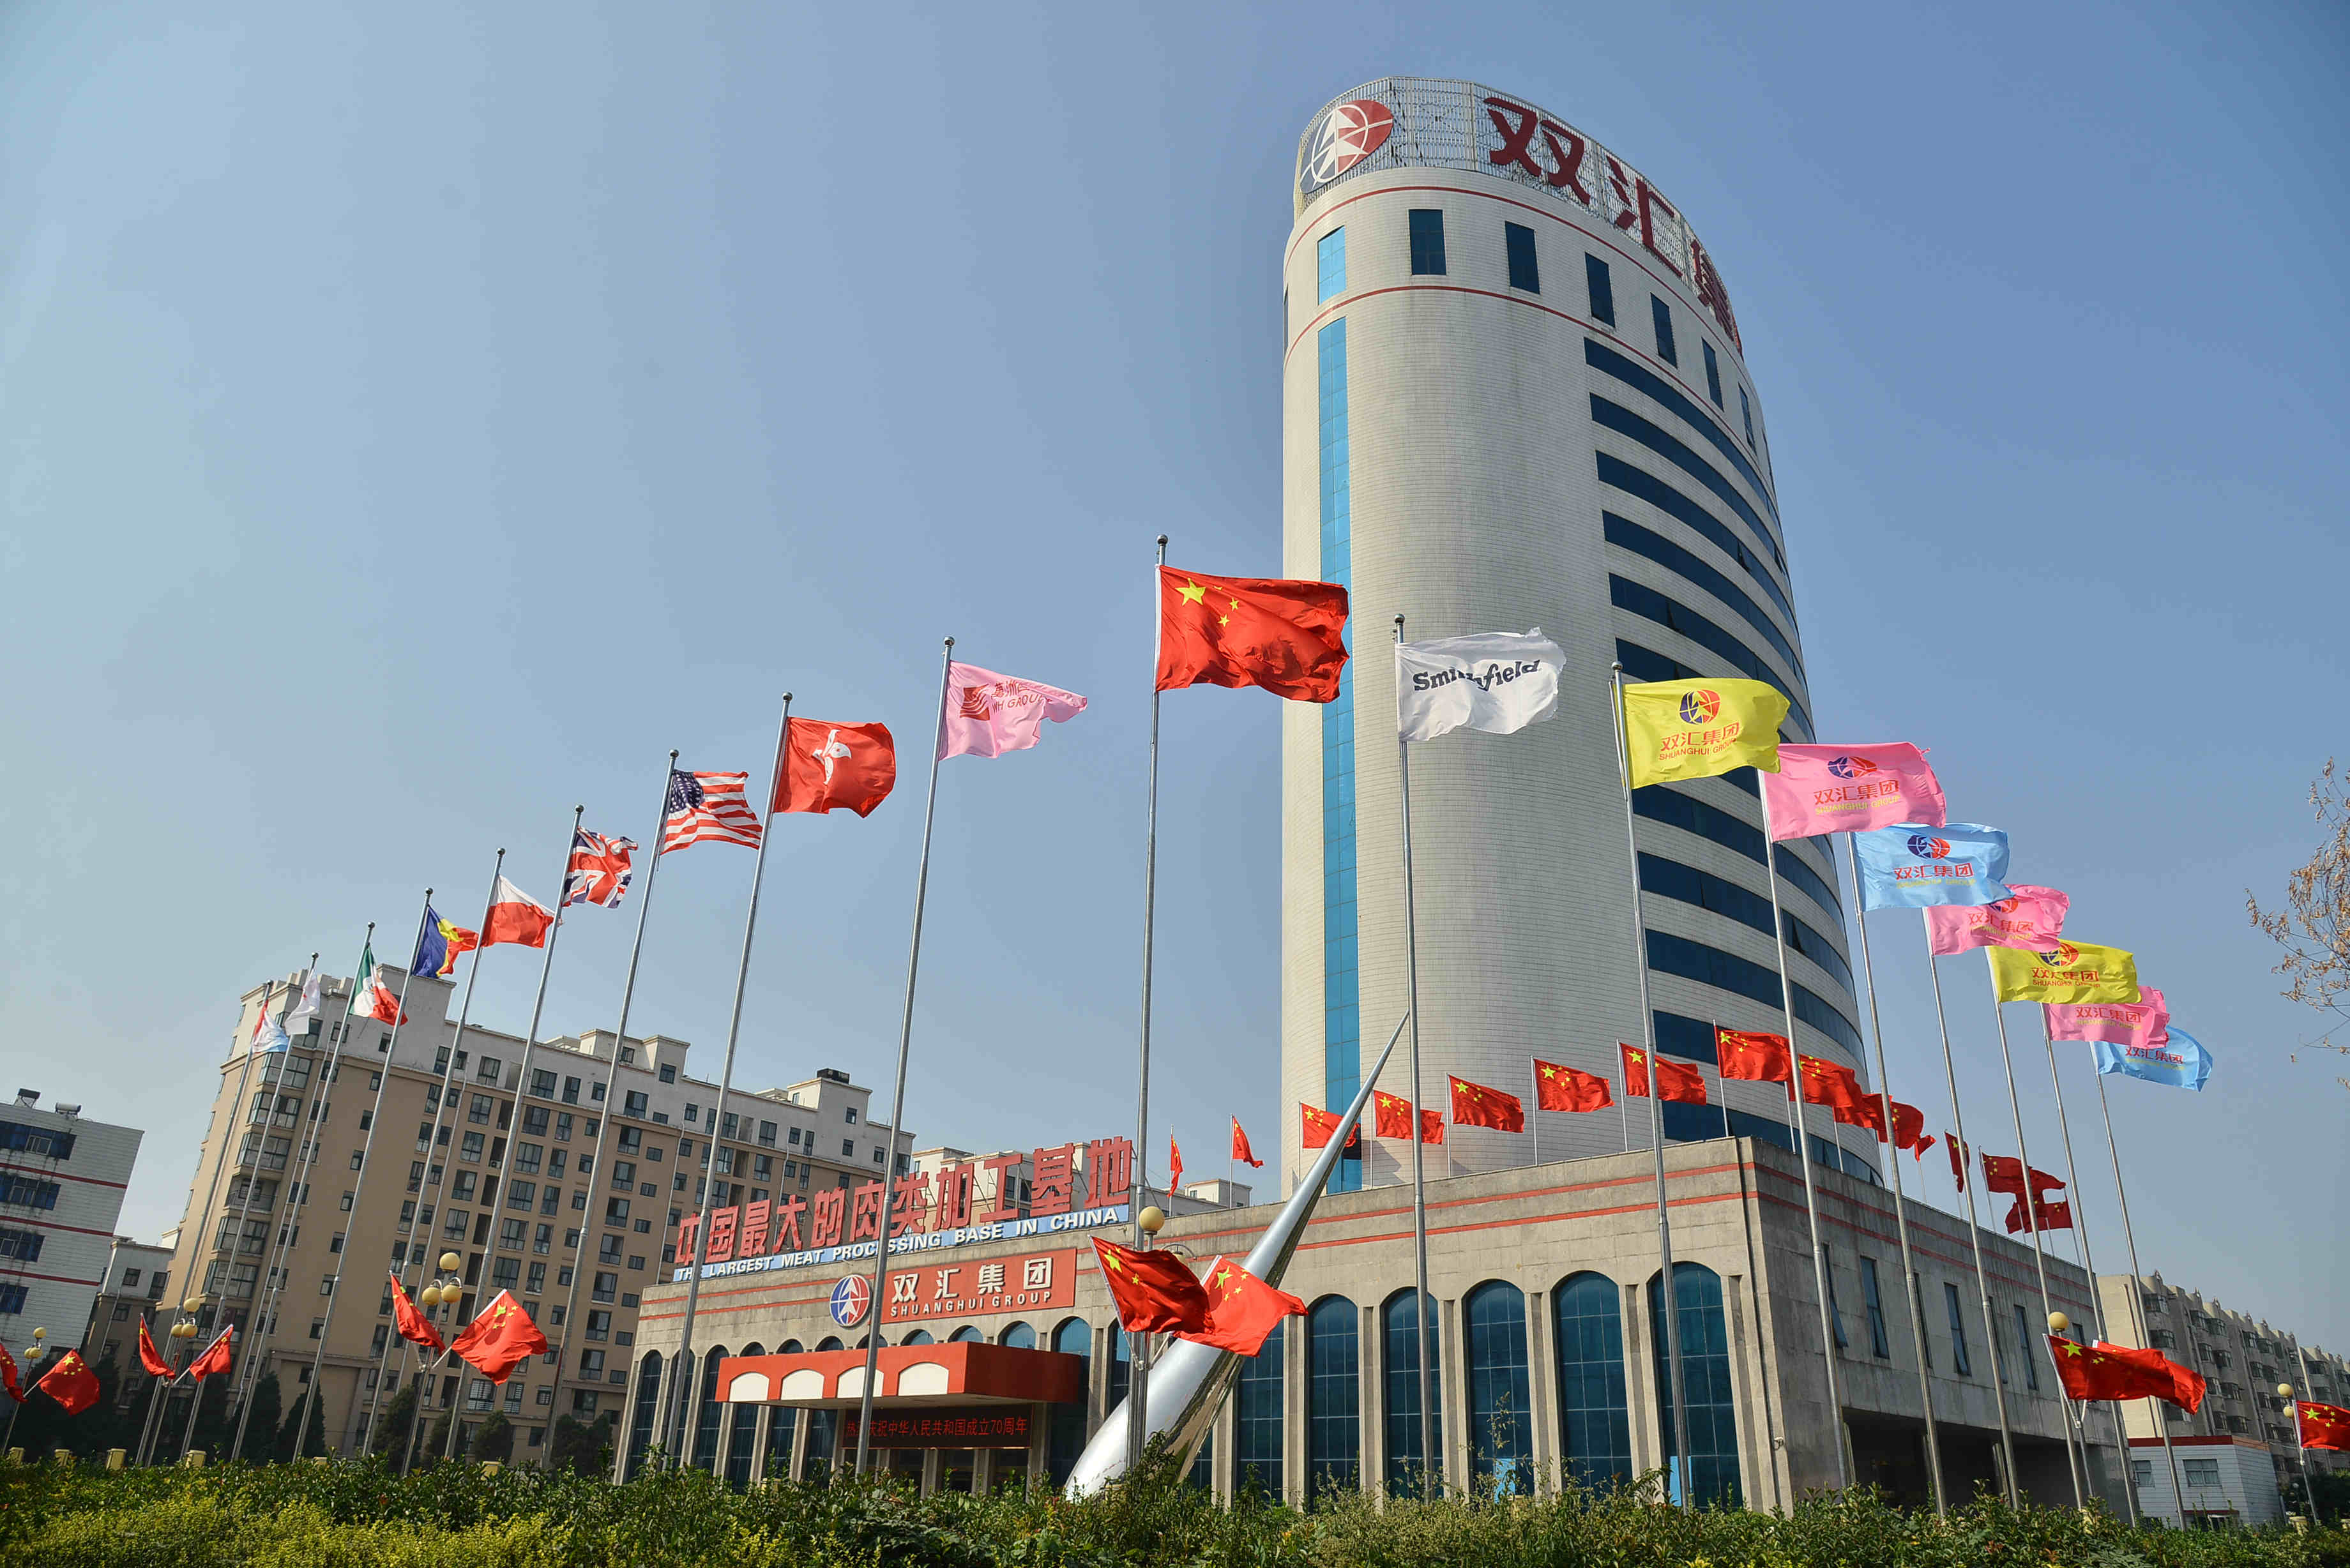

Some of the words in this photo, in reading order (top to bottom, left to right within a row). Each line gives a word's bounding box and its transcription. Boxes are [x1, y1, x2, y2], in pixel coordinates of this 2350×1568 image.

[1660, 722, 1740, 751] 双汇集团
[1659, 747, 1709, 761] SHUANGHUI
[1813, 780, 1900, 805] 双汇集团
[1893, 863, 1974, 880] 双汇集团
[2075, 1006, 2141, 1023] 双汇集团
[674, 1136, 1132, 1265] 中国最大的肉类加工基地
[679, 1267, 702, 1280] TH
[709, 1257, 774, 1277] LARGEST
[781, 1249, 824, 1267] MEAT
[833, 1233, 941, 1260] PROCSSING
[955, 1223, 1005, 1244] BASE
[1016, 1219, 1038, 1235] IN
[1050, 1207, 1119, 1230] CHINA
[891, 1257, 1053, 1303] 双汇集团
[890, 1297, 985, 1317] SHUANGHUI
[992, 1291, 1052, 1308] GROUP
[847, 1416, 1027, 1436] 热庆祝中华人民共和国成立70周年
